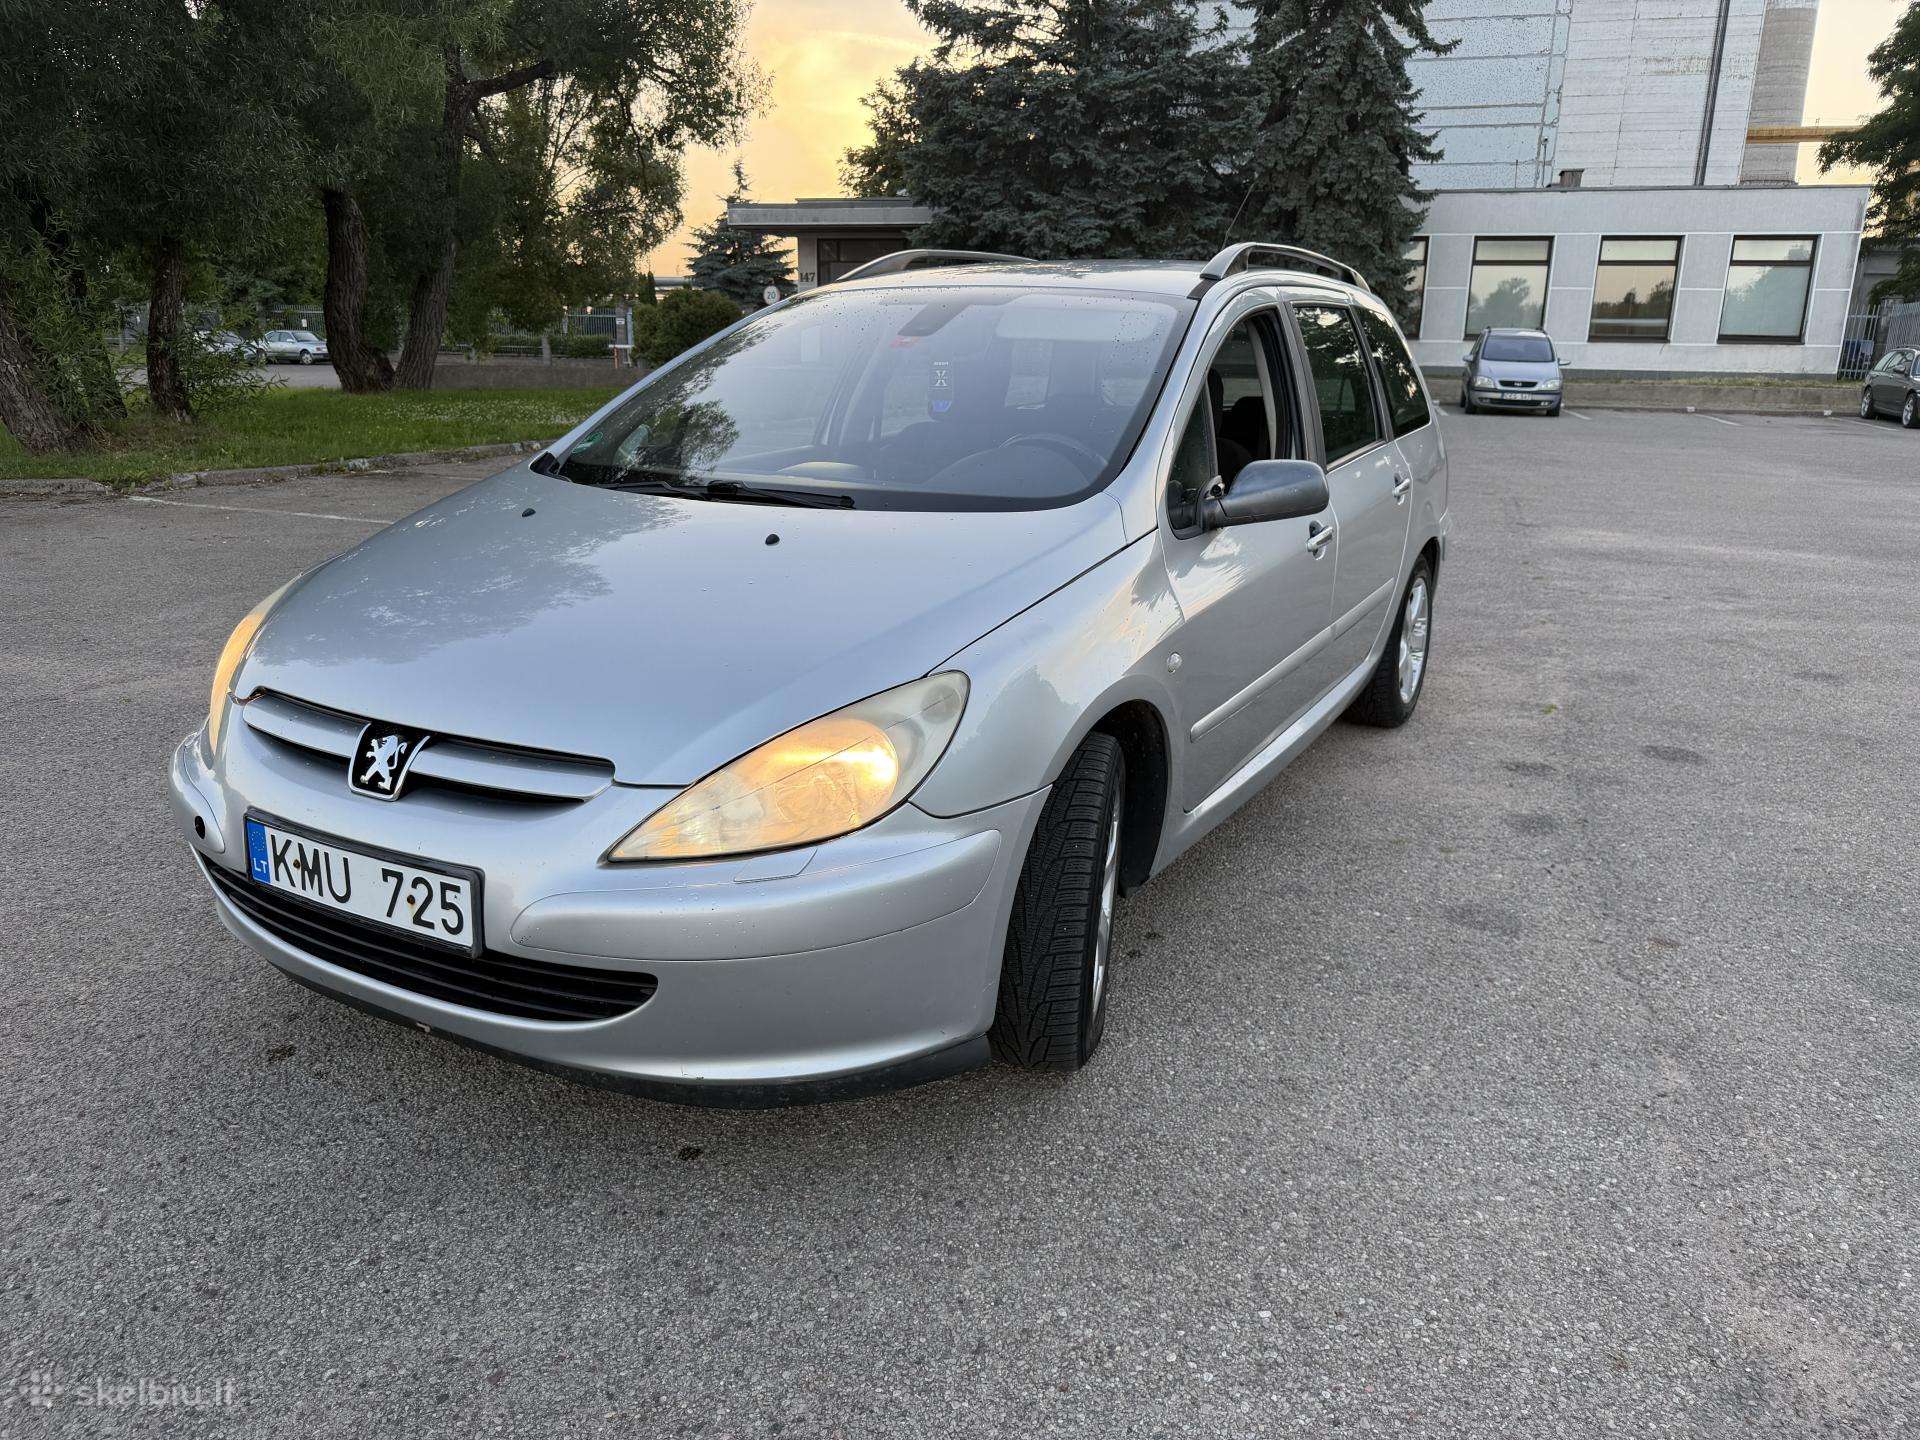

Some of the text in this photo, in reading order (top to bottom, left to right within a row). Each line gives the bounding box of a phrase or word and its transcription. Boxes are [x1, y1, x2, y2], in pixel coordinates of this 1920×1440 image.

[253, 857, 267, 873] LT
[271, 834, 464, 935] KMU 725
